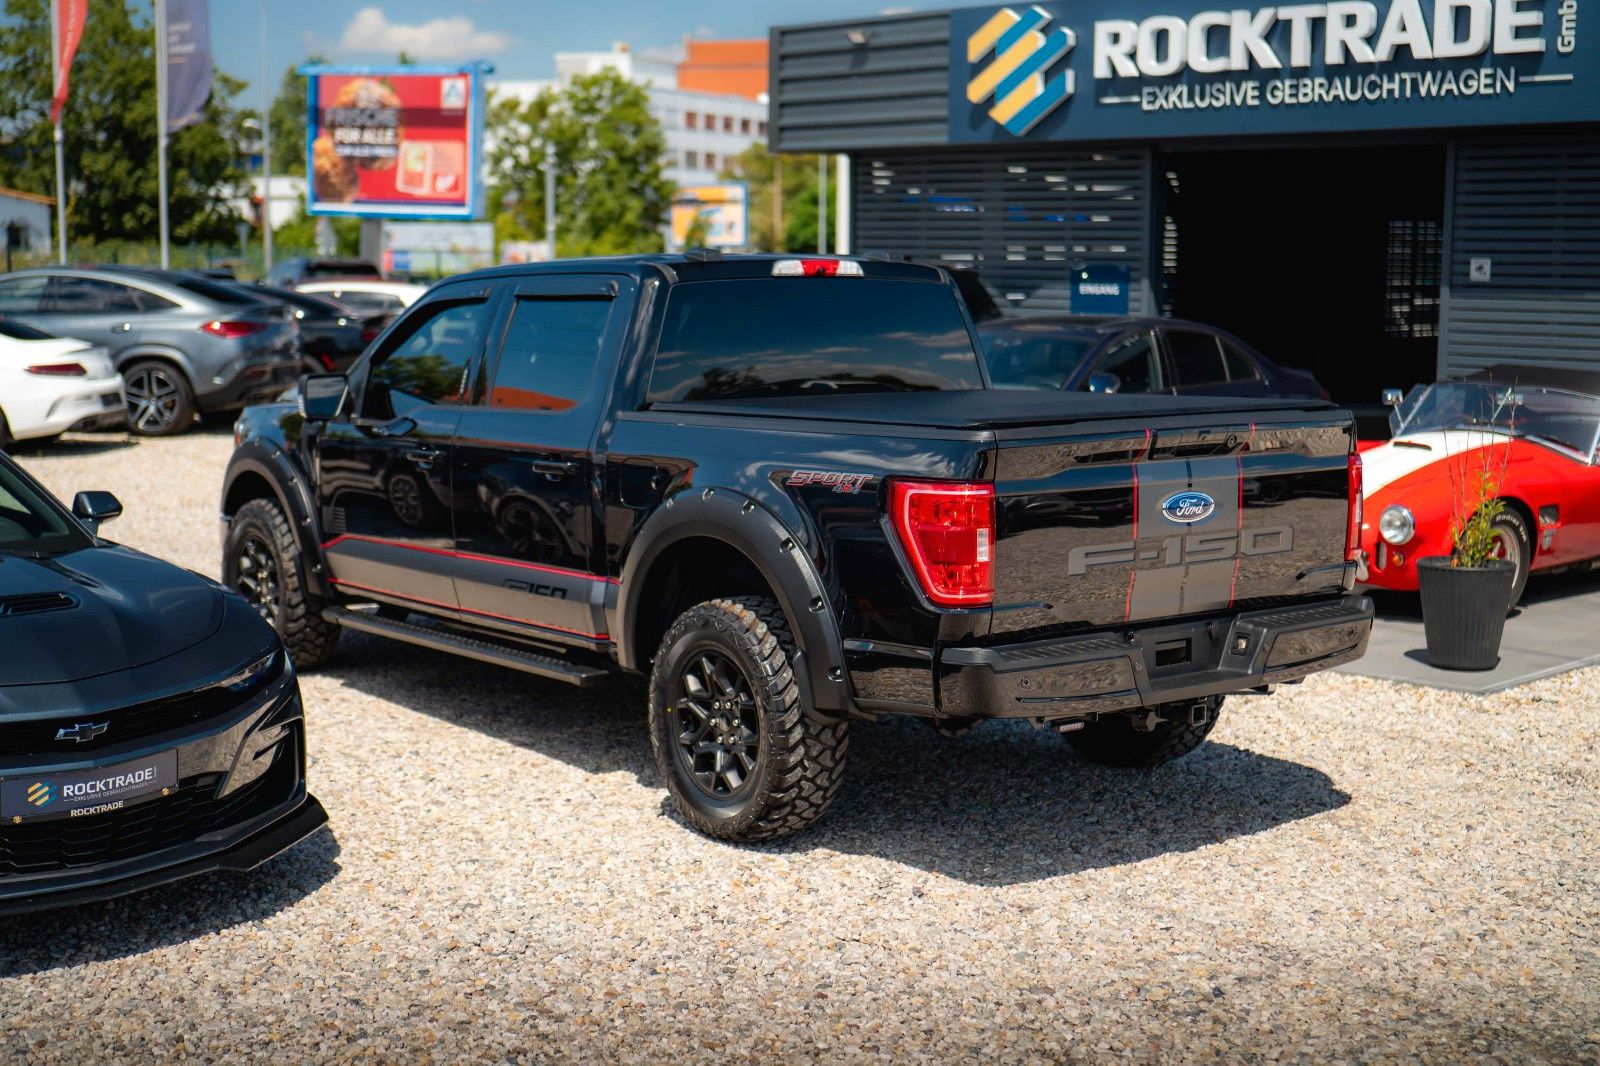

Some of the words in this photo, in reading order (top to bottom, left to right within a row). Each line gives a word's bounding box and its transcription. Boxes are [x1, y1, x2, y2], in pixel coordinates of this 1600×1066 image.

[1093, 0, 1546, 79] ROCKTRADE
[1557, 0, 1578, 53] Gmb
[1141, 80, 1261, 111] EXKLUSIVE
[1265, 67, 1516, 105] GEBRAUCHTWAGEN
[786, 470, 874, 489] SPORT
[1176, 498, 1204, 516] Ford
[1067, 526, 1294, 576] F-150
[63, 767, 153, 797] ROCKTRADE
[70, 800, 124, 817] ROCKTRADE
